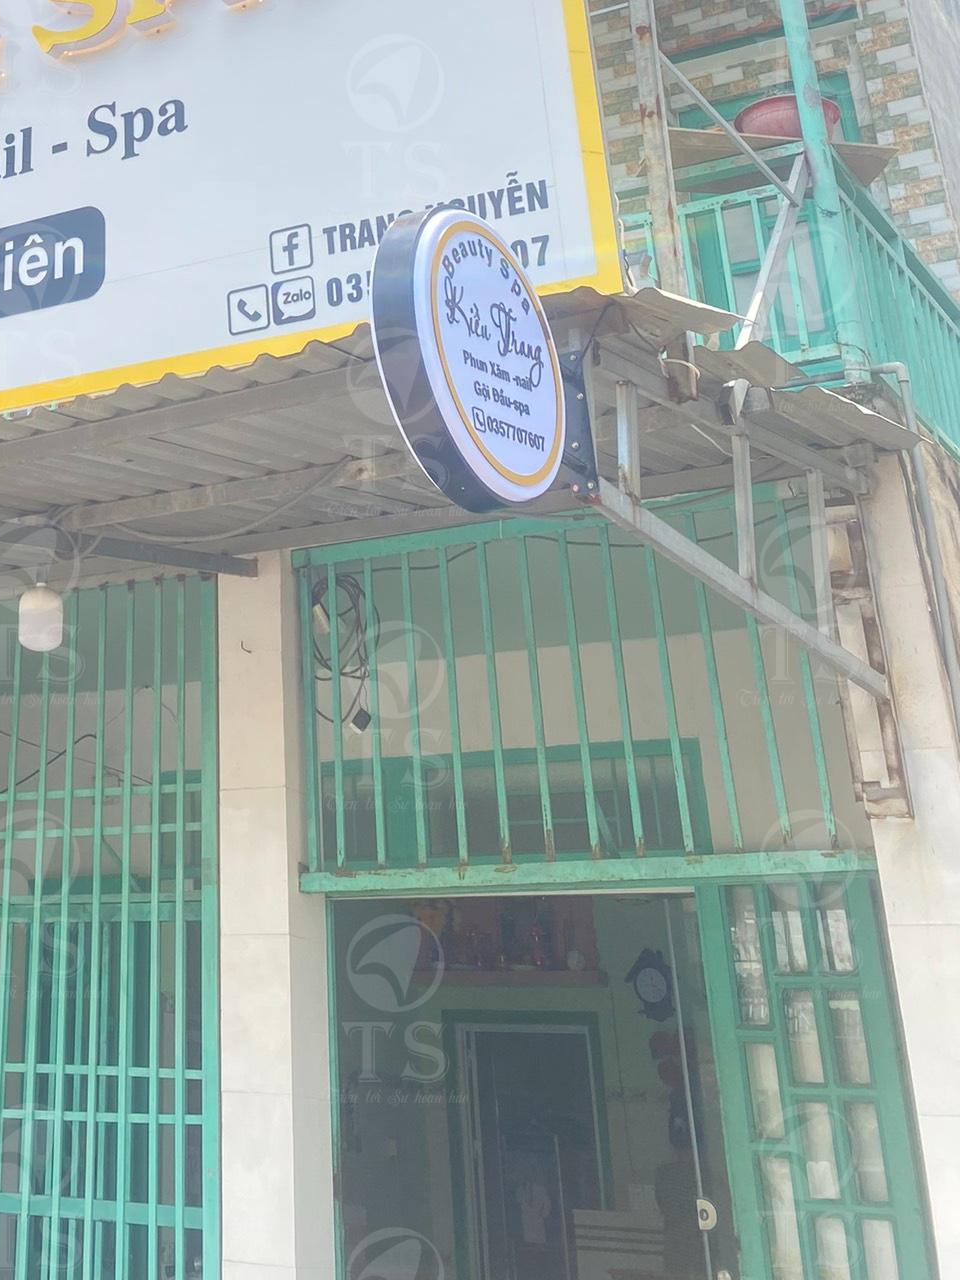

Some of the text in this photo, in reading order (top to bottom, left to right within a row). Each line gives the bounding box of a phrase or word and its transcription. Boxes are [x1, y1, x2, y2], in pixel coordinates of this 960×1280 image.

[86, 96, 188, 160] Spa
[442, 239, 493, 279] Beauty
[283, 287, 312, 305] Zalo
[462, 349, 488, 373] Phun
[489, 361, 510, 382] Xăm
[473, 380, 491, 402] Gội
[486, 415, 545, 452] 0357707607
